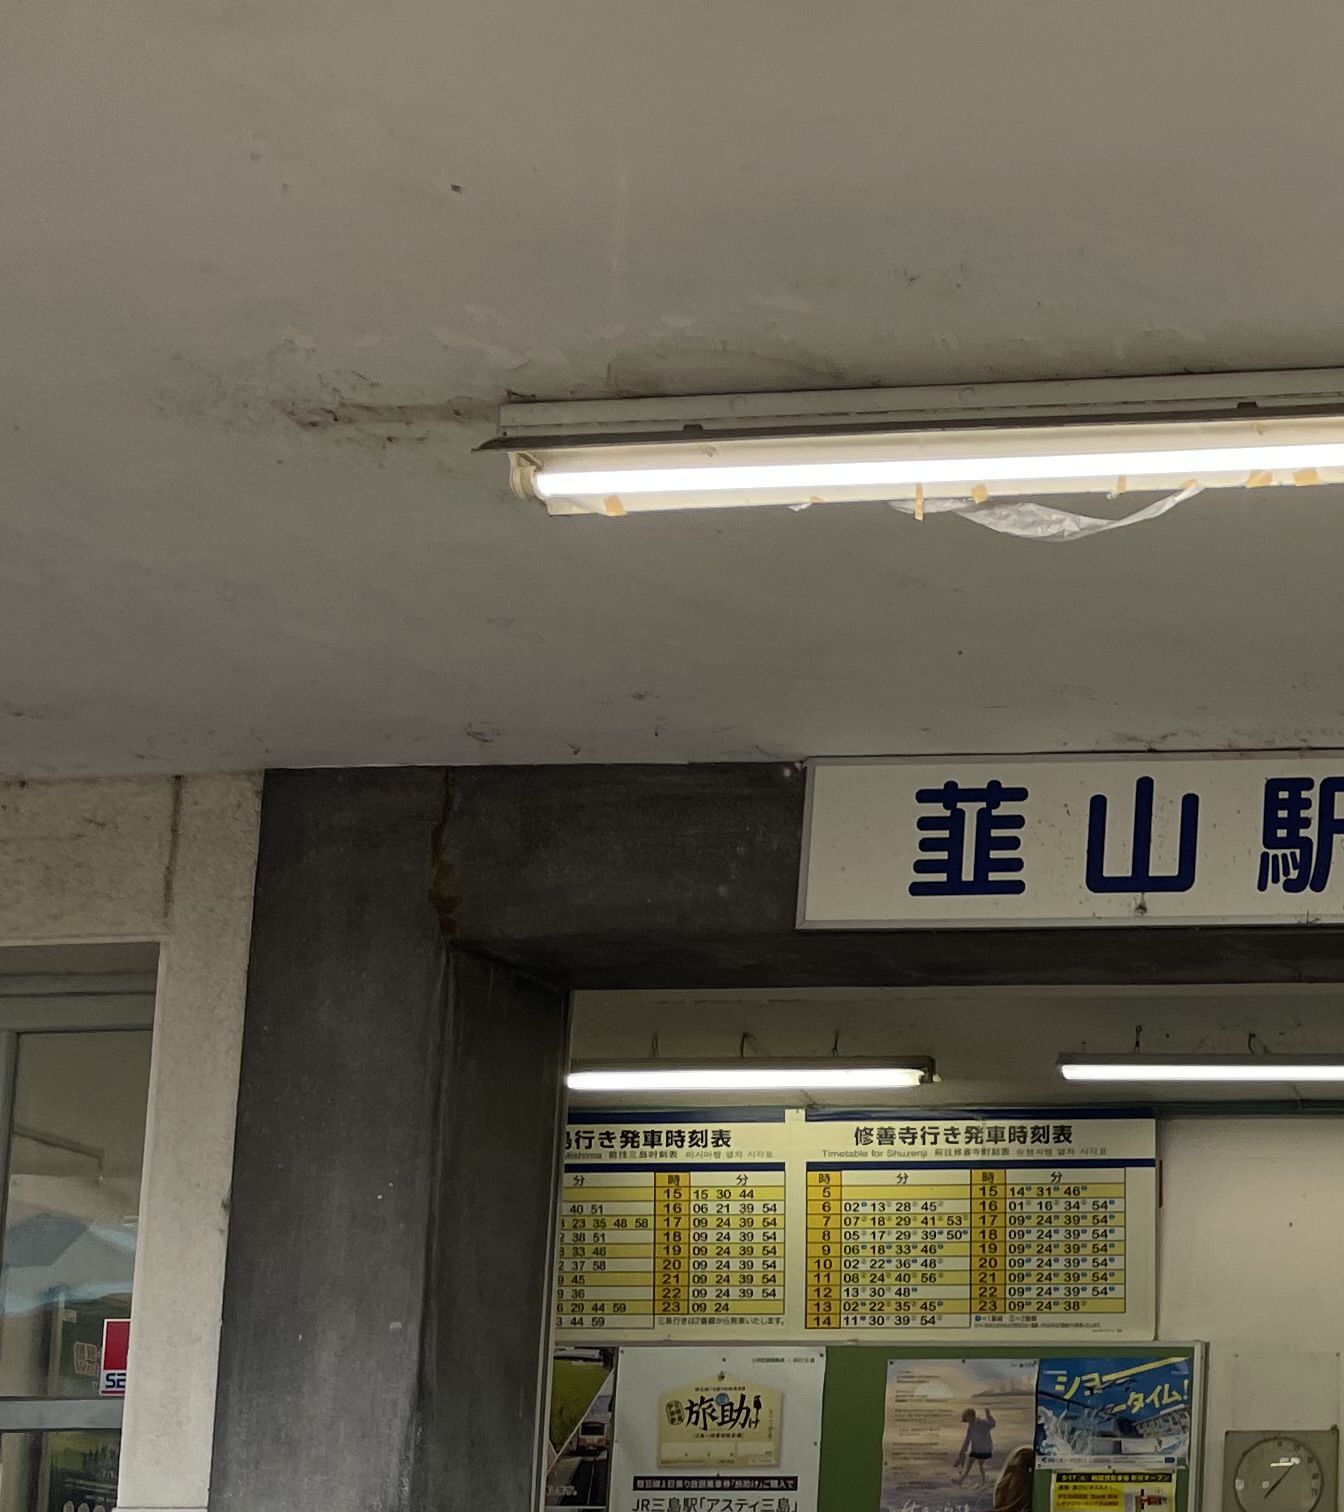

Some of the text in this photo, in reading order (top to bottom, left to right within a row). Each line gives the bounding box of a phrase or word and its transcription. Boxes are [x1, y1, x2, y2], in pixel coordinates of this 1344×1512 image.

[853, 1124, 1074, 1147] 修善寺行き発車時刻表
[664, 1189, 754, 1199] 15 15 30 44
[663, 1203, 777, 1213] 16 06 21 39 54
[663, 1218, 777, 1228] 17 09 24 39 54
[663, 1232, 682, 1242] 18
[662, 1246, 682, 1256] 19
[662, 1260, 681, 1270] 20
[662, 1274, 681, 1284] 21
[662, 1288, 681, 1298] 22
[662, 1303, 730, 1313] 23 09 24
